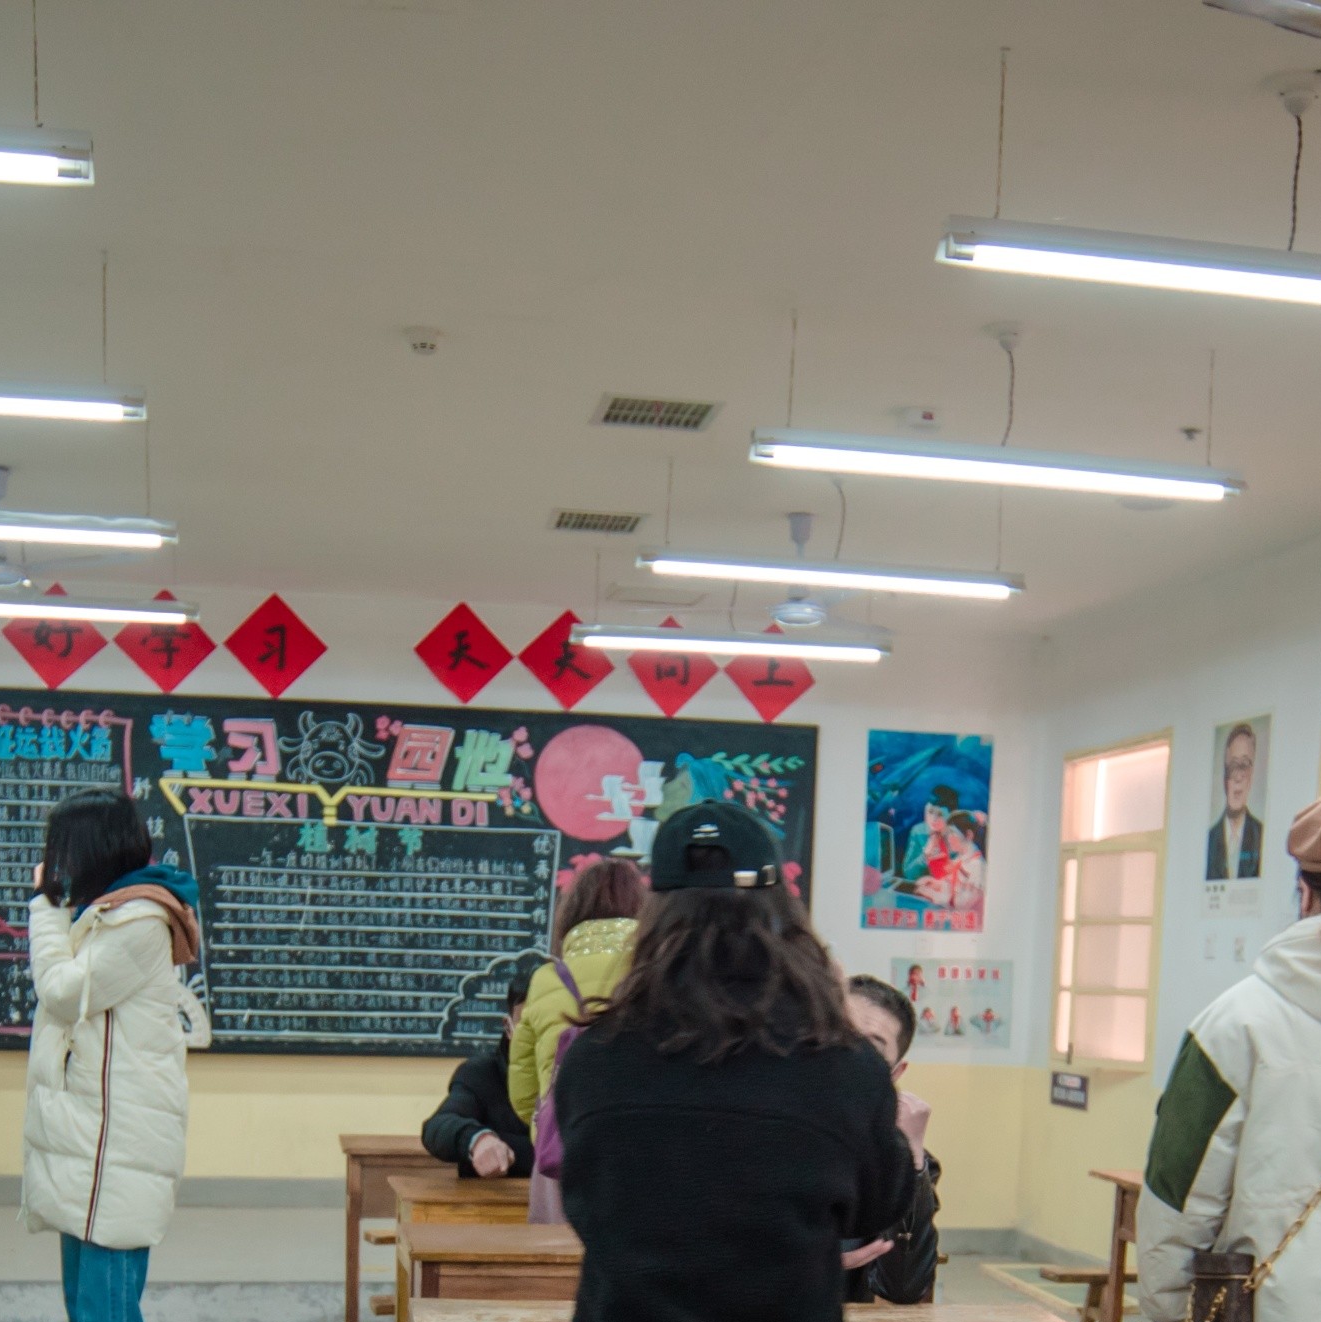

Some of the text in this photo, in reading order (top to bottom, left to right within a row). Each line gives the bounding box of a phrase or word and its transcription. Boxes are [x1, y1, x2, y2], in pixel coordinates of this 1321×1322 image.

[150, 713, 515, 792] 学习 园地
[188, 787, 489, 827] XUEXI YUAN DI
[296, 821, 423, 856] 植树节
